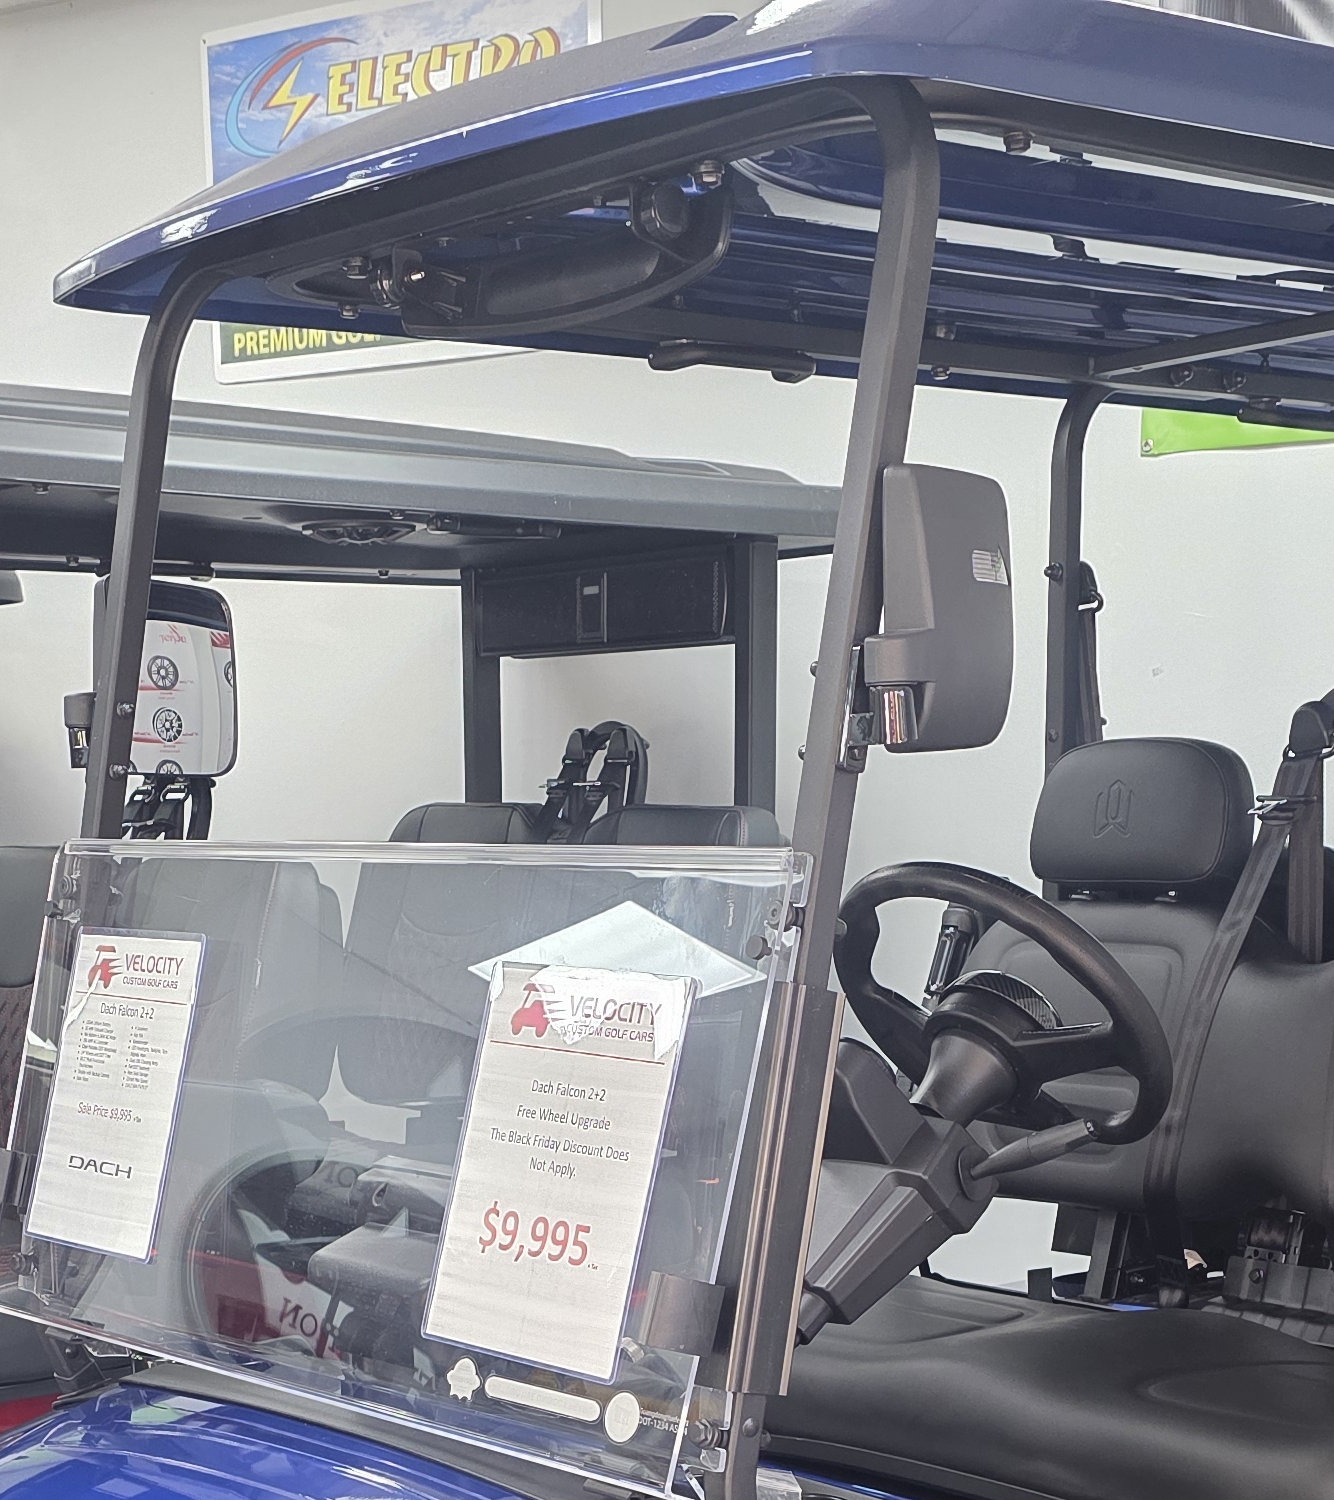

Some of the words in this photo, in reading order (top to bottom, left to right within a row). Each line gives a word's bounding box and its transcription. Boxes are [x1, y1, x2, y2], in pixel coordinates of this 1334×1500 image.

[234, 327, 327, 357] PREMIUM
[125, 953, 184, 976] VELOCITY
[122, 976, 146, 987] CUSTOM
[147, 978, 162, 987] GOLF
[162, 980, 178, 989] CARS
[100, 1003, 116, 1014] Dach
[118, 1004, 138, 1018] Falcon
[140, 1007, 154, 1019] 2+2
[570, 995, 662, 1026] VELOCITY
[566, 1023, 602, 1037] CUSTOM
[604, 1027, 628, 1039] GOLF
[629, 1031, 654, 1042] CARS
[531, 1080, 554, 1095] Dach
[556, 1083, 586, 1099] Falcon
[588, 1088, 606, 1102] 2+2
[77, 1101, 91, 1114] Sale
[92, 1104, 108, 1117] Price
[109, 1107, 132, 1122] $9,995
[517, 1105, 537, 1119] Free
[539, 1108, 569, 1124] Wheel
[570, 1112, 611, 1131] Upgrade
[490, 1128, 506, 1142] The
[508, 1130, 531, 1146] Black
[533, 1134, 561, 1153] Friday
[563, 1139, 604, 1157] Discount
[605, 1146, 629, 1162] Does
[68, 1155, 132, 1179] DACH
[529, 1157, 546, 1171] Not
[548, 1161, 576, 1179] Apply.
[478, 1200, 591, 1266] $9,995
